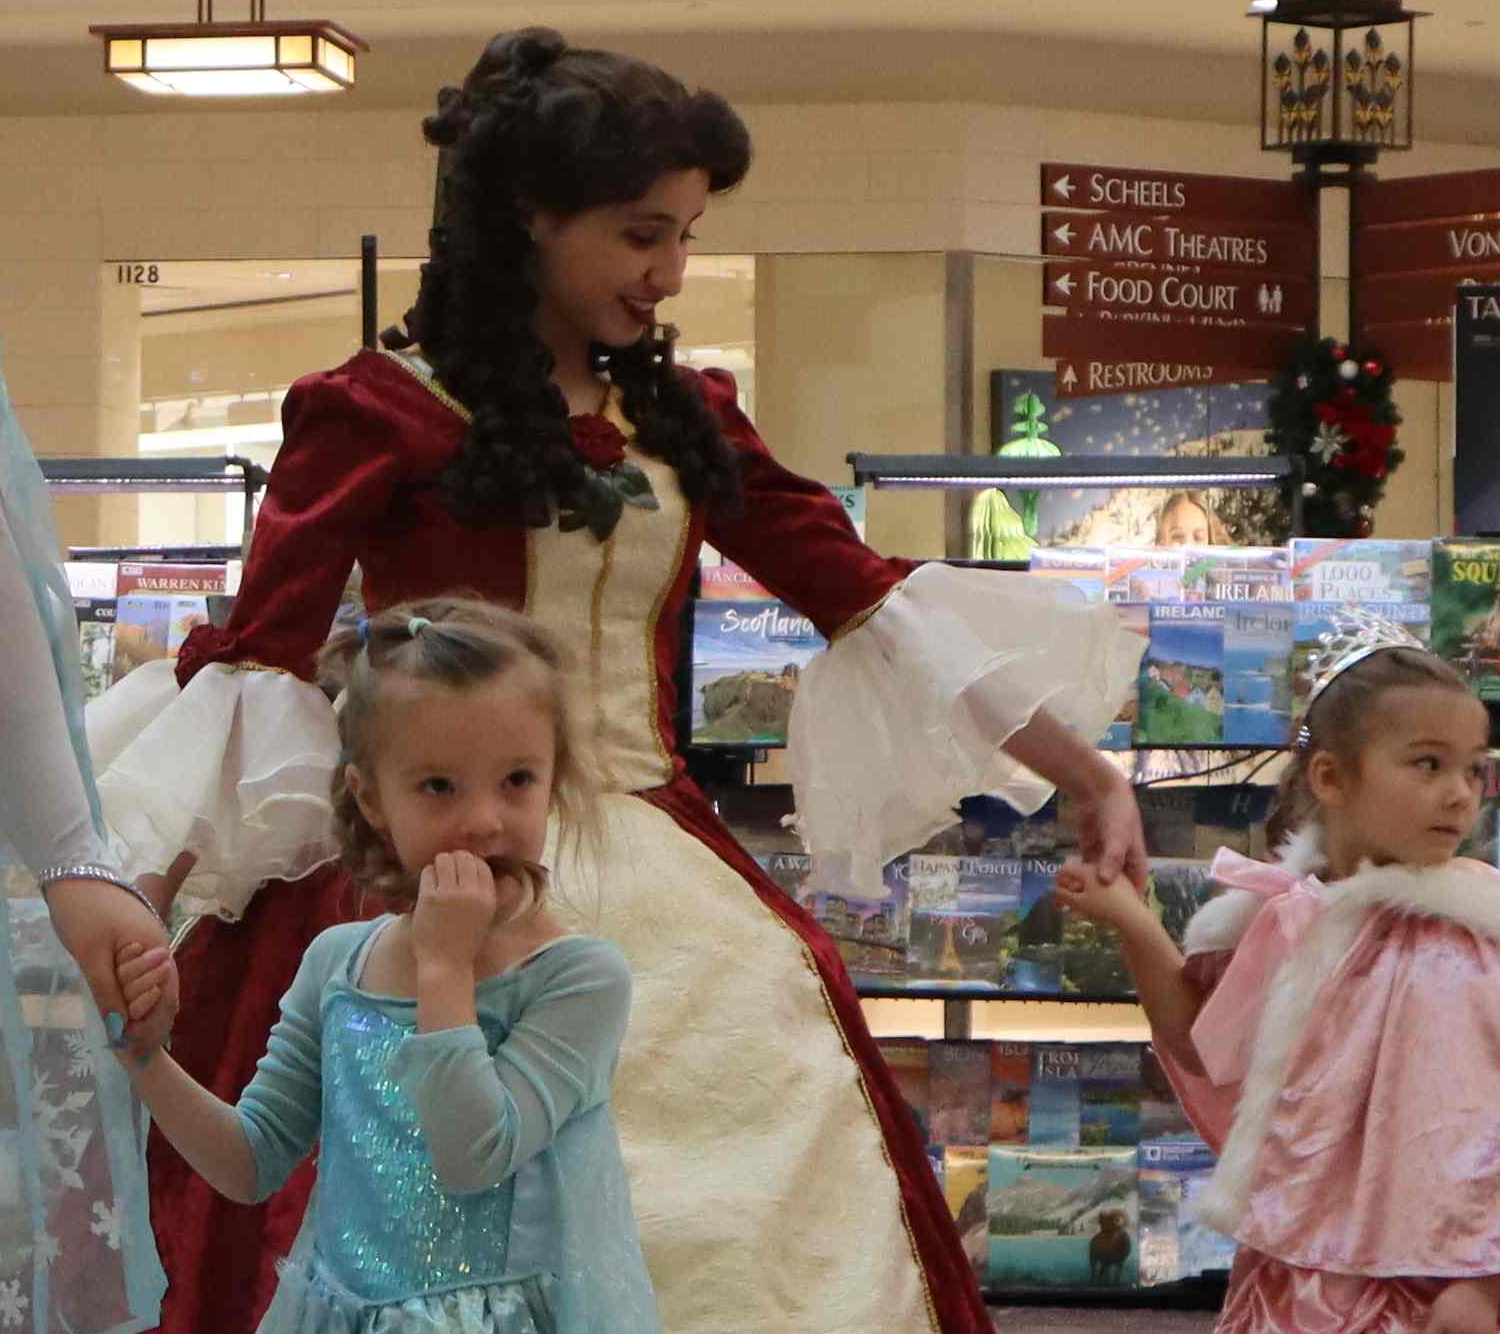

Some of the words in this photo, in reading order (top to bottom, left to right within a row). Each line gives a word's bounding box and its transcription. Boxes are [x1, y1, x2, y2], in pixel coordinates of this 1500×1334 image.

[1090, 173, 1187, 209] SCHEELS
[1088, 222, 1154, 256] AMC
[1163, 226, 1269, 265] THEATRES
[117, 264, 160, 285] 1128
[1087, 271, 1153, 305] FOOD
[1160, 276, 1240, 311] COURT
[136, 576, 200, 591] WARREN
